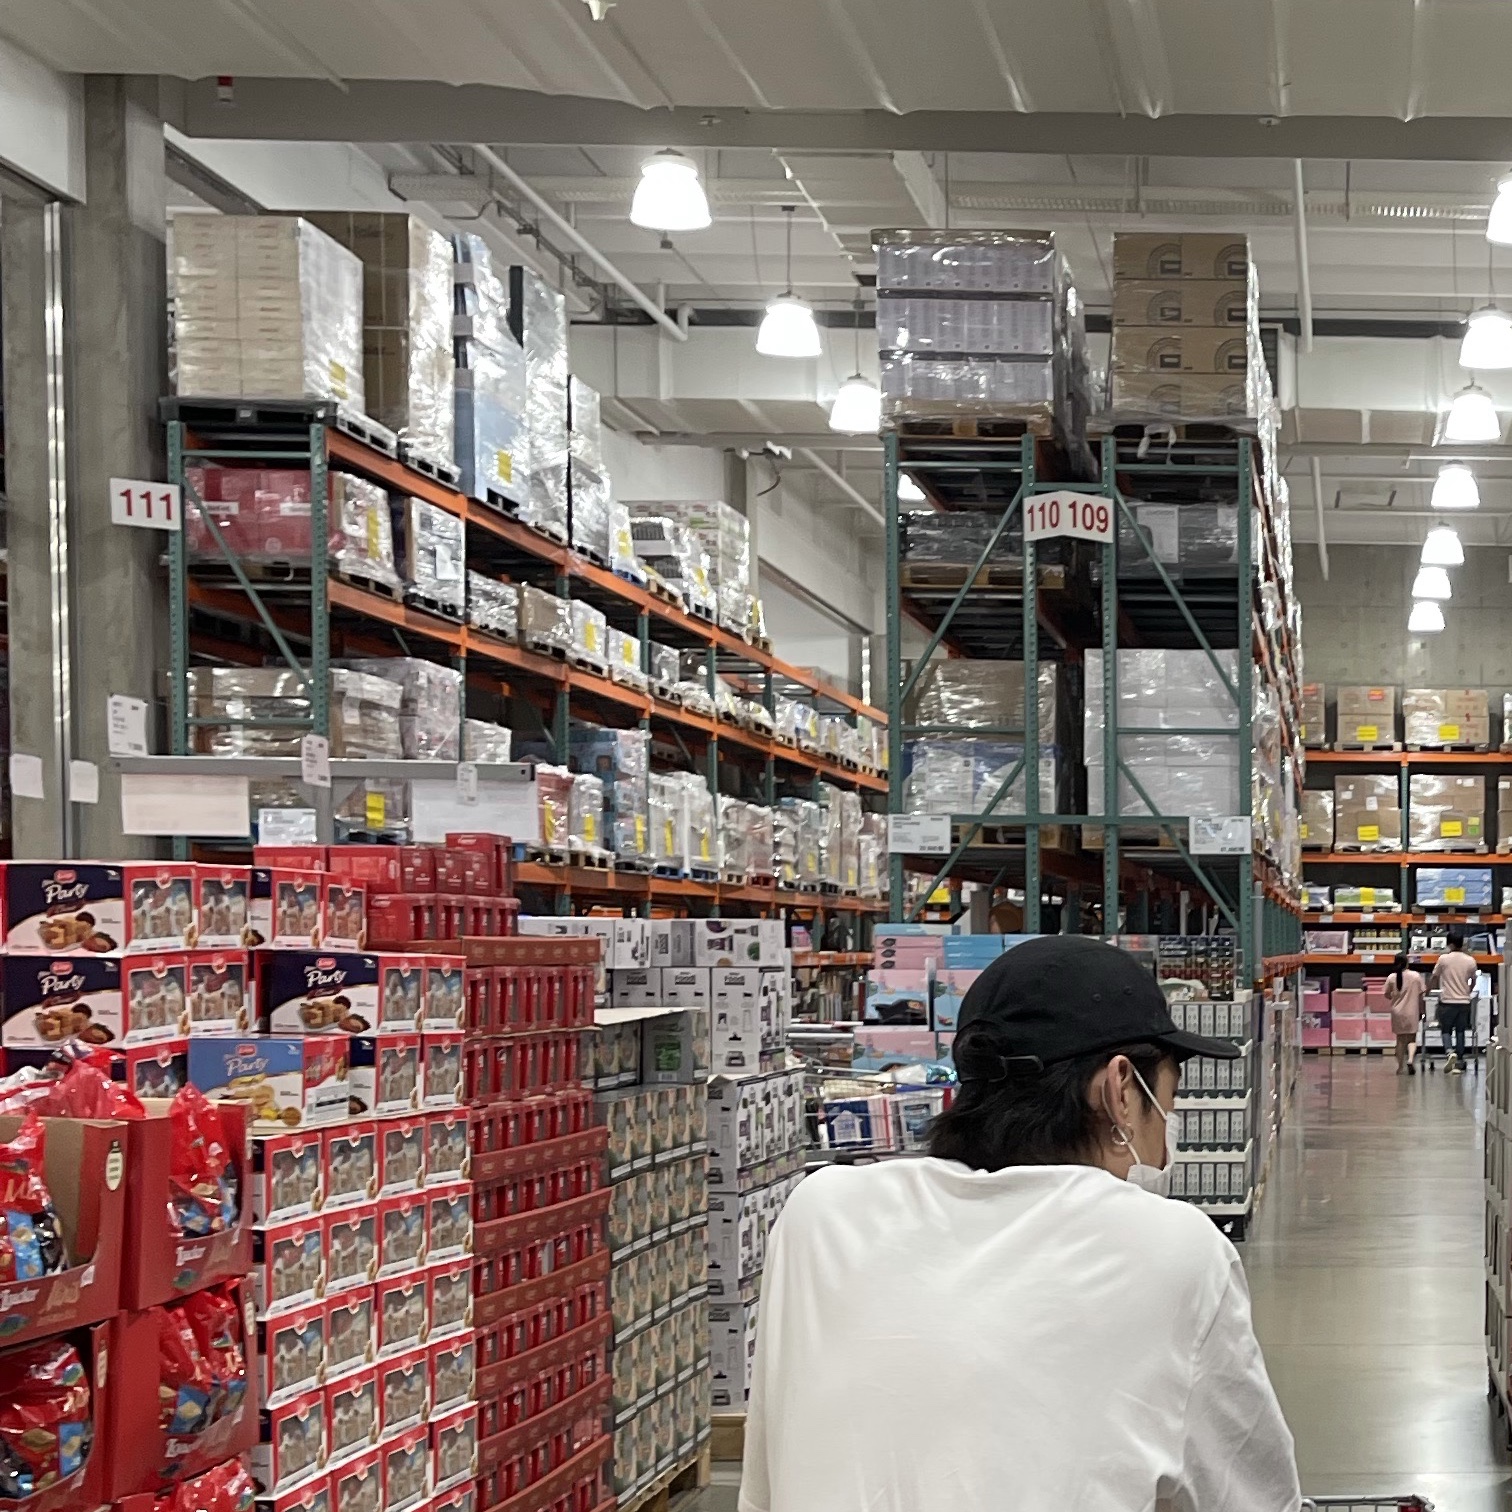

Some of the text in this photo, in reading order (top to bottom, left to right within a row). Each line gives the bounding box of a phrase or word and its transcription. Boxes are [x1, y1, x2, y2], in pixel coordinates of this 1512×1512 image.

[120, 489, 173, 521] 111
[1026, 499, 1110, 534] 110 109
[45, 879, 91, 904] Party
[40, 970, 87, 995] Party
[307, 968, 349, 991] Party
[225, 1055, 270, 1076] Party
